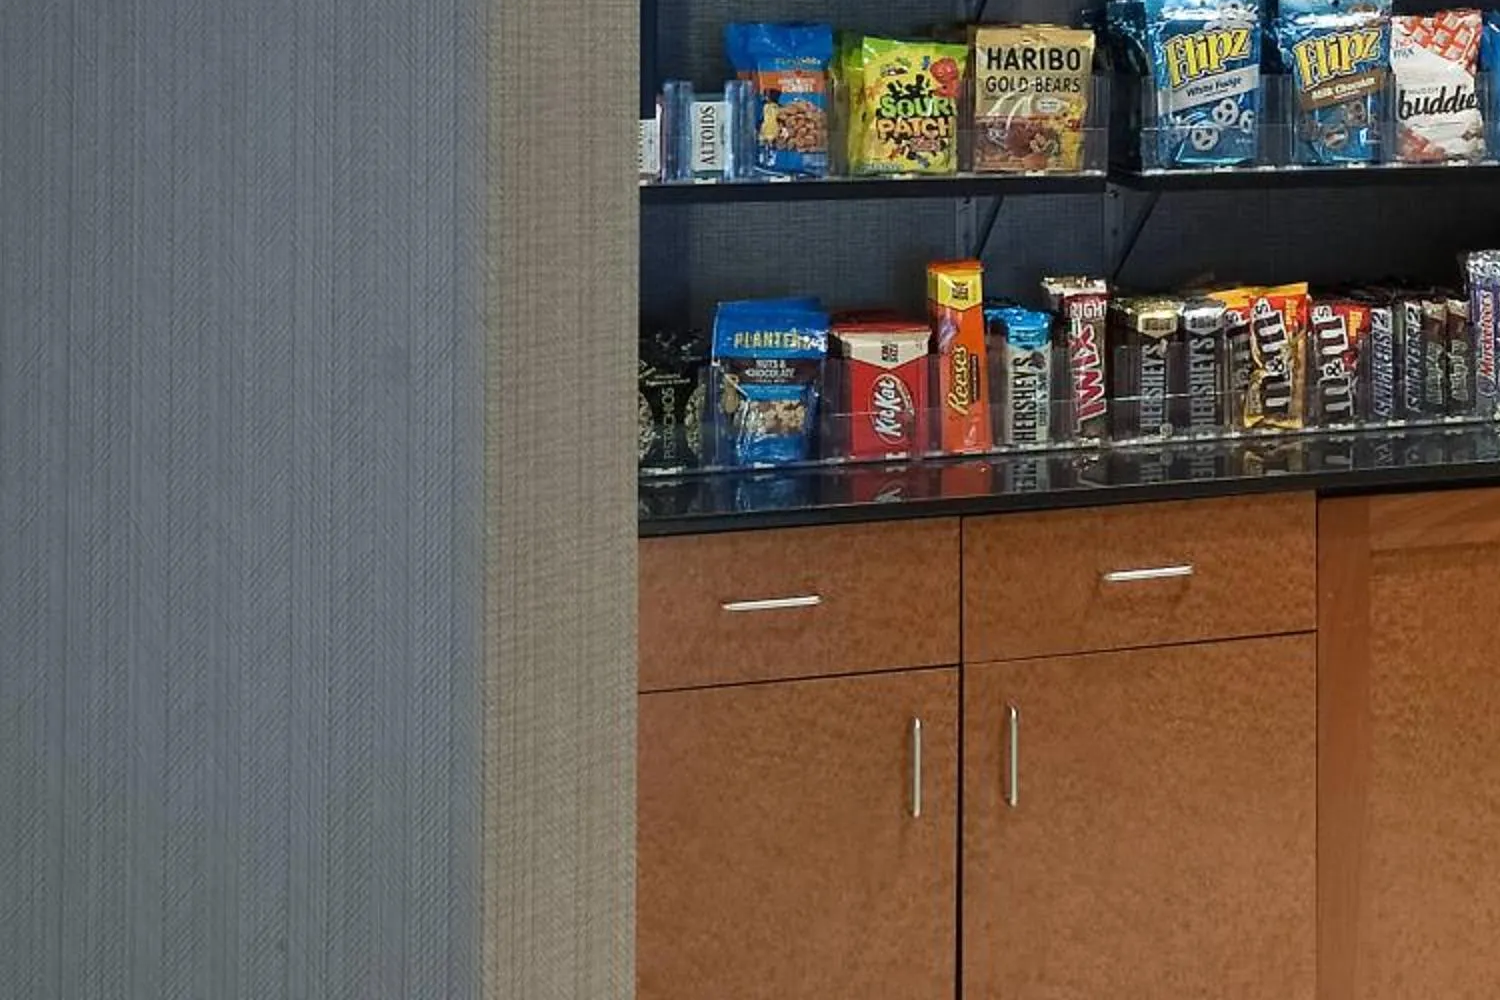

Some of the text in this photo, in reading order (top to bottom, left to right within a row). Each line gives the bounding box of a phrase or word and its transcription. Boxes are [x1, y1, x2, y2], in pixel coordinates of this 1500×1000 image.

[986, 46, 1081, 71] HARIBO
[1166, 27, 1250, 89] Flipz
[1295, 30, 1381, 90] Flipz
[985, 75, 1081, 93] GOLD-BEARS
[876, 116, 953, 139] PATCH
[879, 96, 951, 118] SOUR
[701, 105, 716, 165] ALTOIDS
[1068, 322, 1107, 421] TWIX
